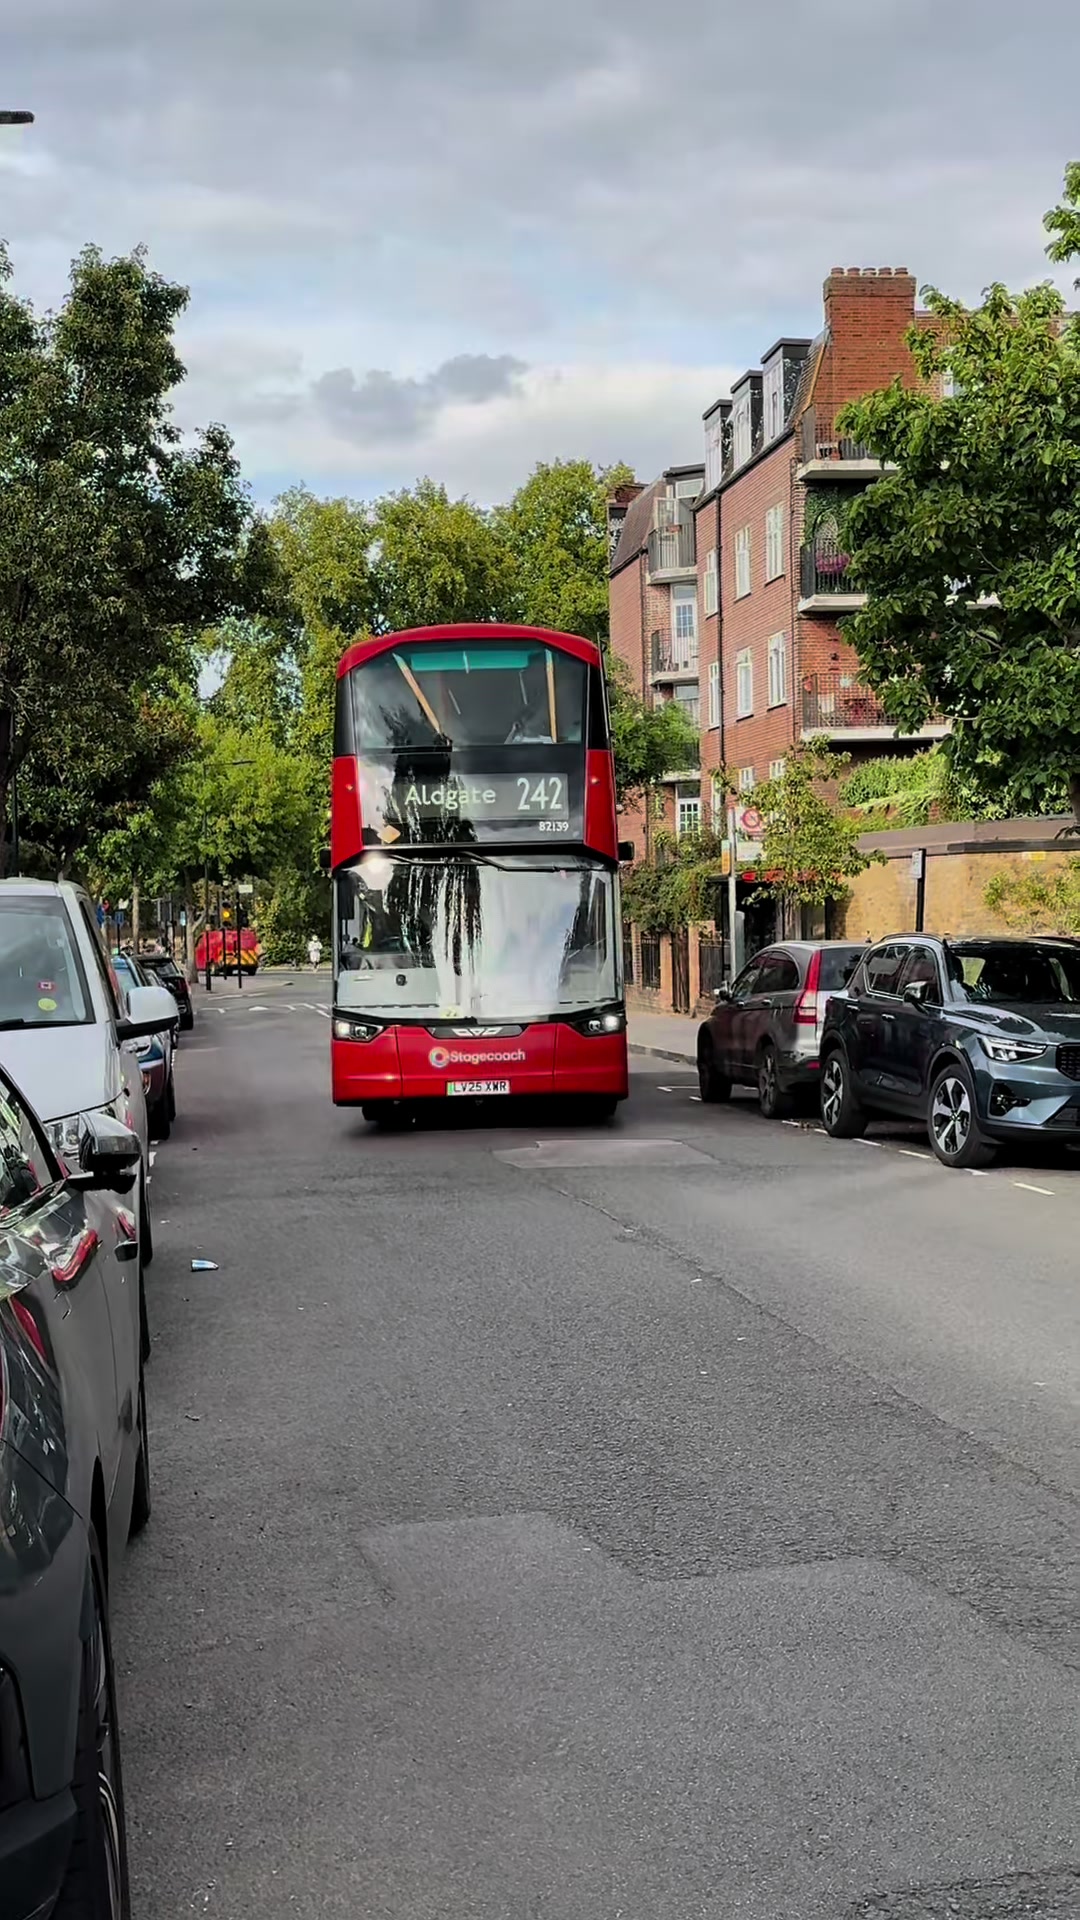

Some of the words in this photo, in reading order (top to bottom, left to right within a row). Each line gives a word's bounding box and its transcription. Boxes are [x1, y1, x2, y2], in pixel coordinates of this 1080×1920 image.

[404, 785, 496, 810] Aldgate
[517, 777, 562, 810] 242
[538, 821, 569, 832] 82139
[450, 1049, 525, 1065] Stagecoach
[453, 1082, 482, 1093] LV25
[485, 1081, 507, 1092] XWR
